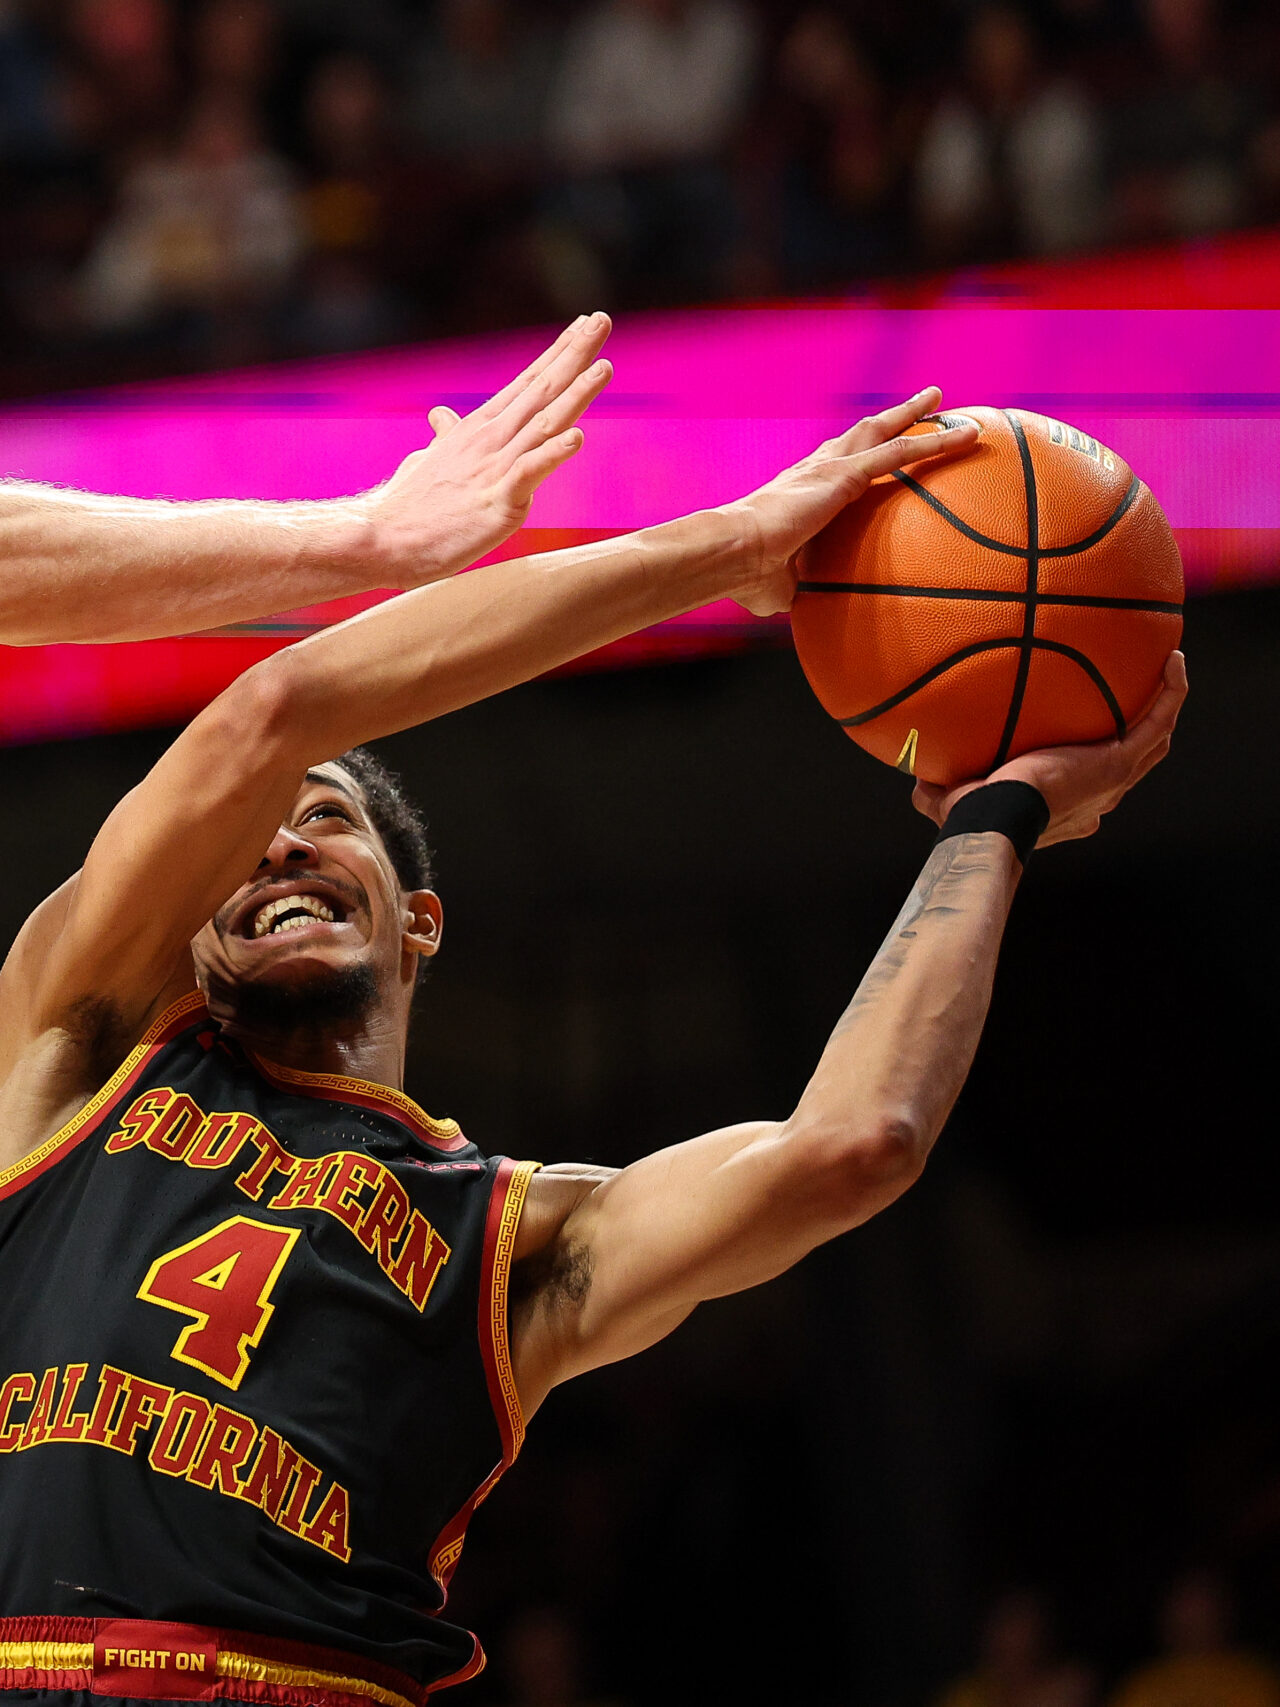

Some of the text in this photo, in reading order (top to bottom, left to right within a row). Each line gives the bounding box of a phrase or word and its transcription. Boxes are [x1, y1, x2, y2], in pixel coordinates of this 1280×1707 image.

[104, 1086, 451, 1313] SOUTHERN
[136, 1214, 302, 1391] 4
[104, 1648, 206, 1671] FIGHT ON
